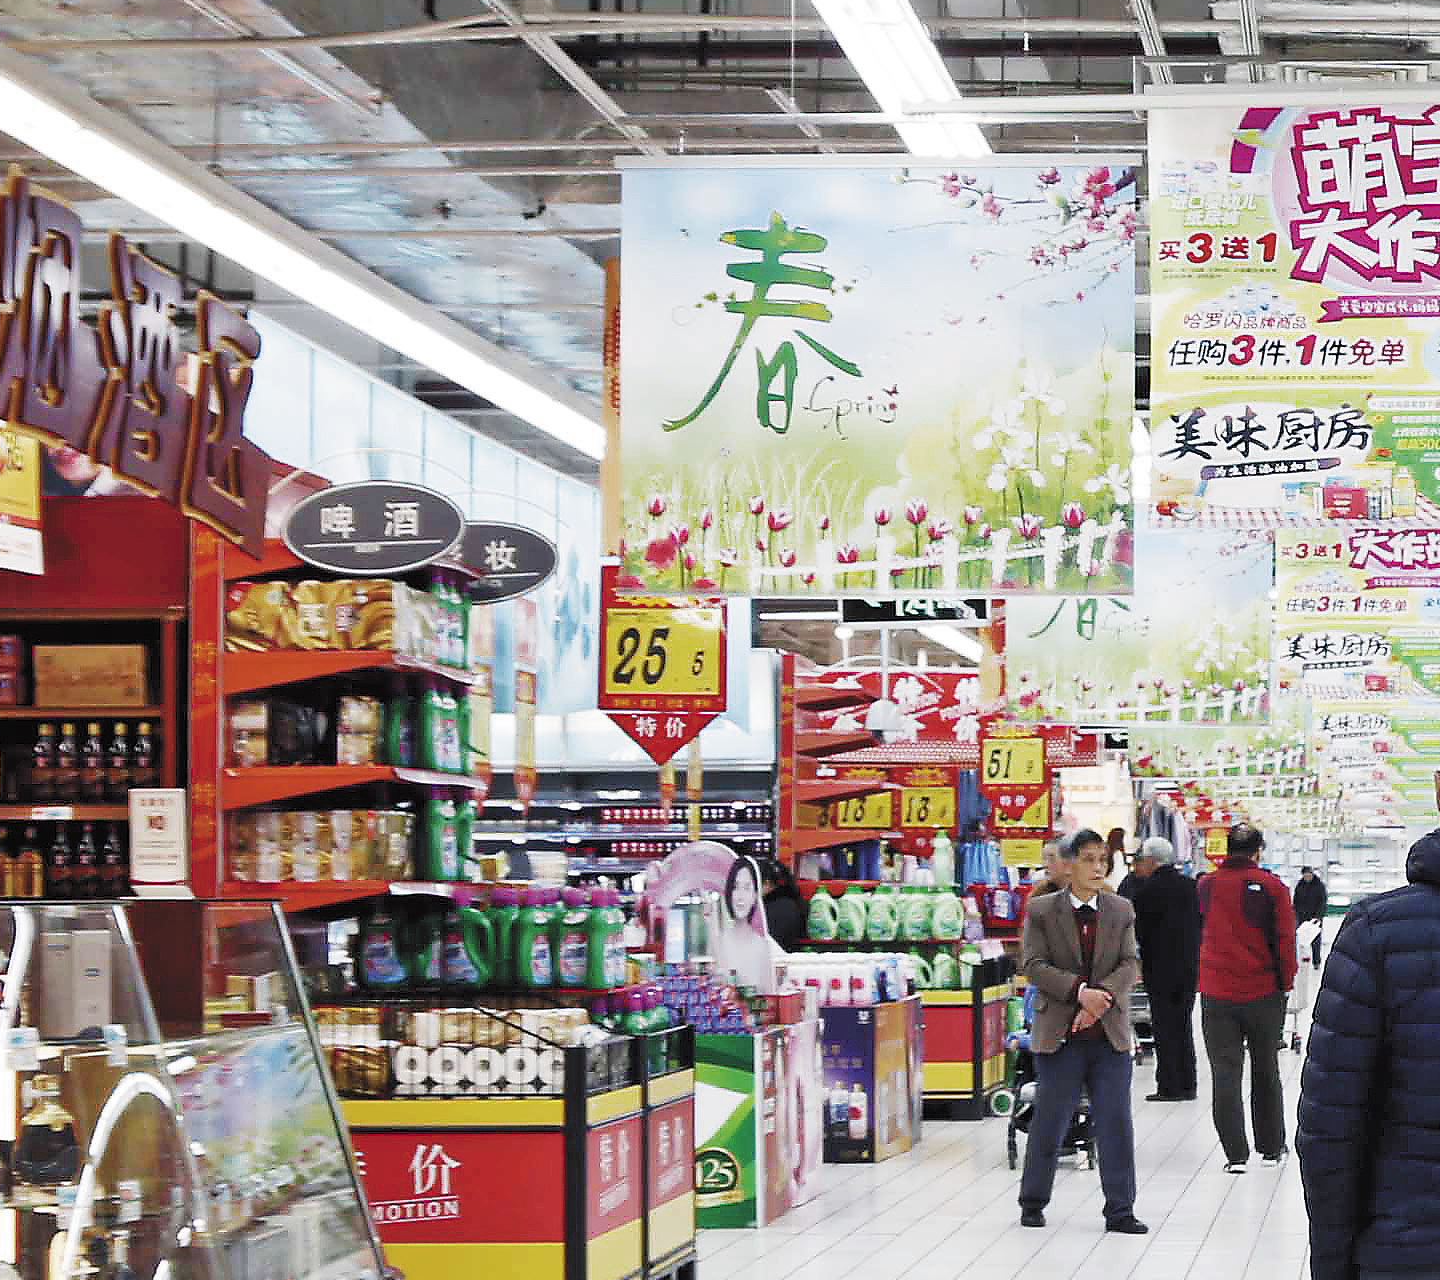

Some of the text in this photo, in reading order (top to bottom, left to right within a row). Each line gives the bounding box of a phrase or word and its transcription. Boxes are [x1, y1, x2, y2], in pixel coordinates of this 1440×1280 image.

[1159, 232, 1278, 265] 买3送1
[663, 210, 863, 433] 春
[802, 375, 898, 440] Spring
[1159, 403, 1373, 460] 美味厨房
[320, 502, 420, 538] 啤酒
[612, 626, 705, 685] 25 5
[635, 716, 686, 739] 特价
